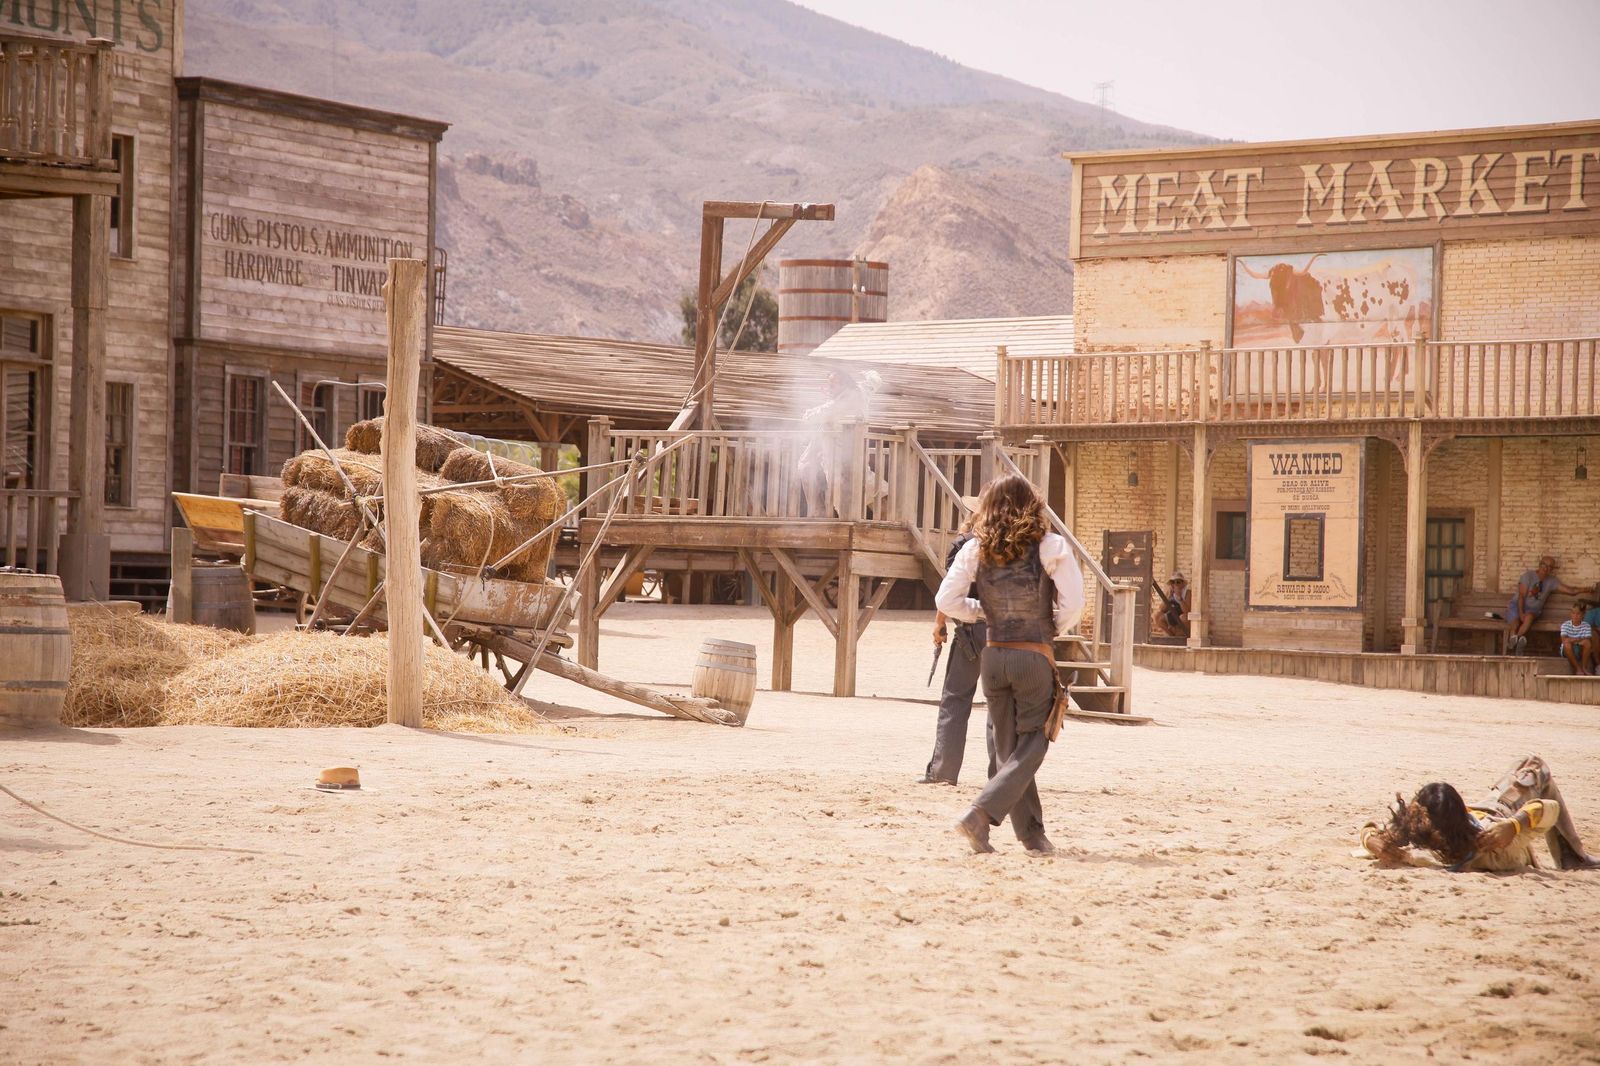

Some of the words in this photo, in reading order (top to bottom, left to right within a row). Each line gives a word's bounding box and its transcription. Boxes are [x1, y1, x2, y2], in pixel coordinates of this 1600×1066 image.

[1093, 167, 1264, 238] MEAT
[1296, 146, 1600, 227] MARKET
[323, 230, 413, 264] AMMUNITION
[224, 250, 304, 287] HARDWARE
[1269, 453, 1343, 475] WANTED
[1276, 584, 1306, 594] REWARD
